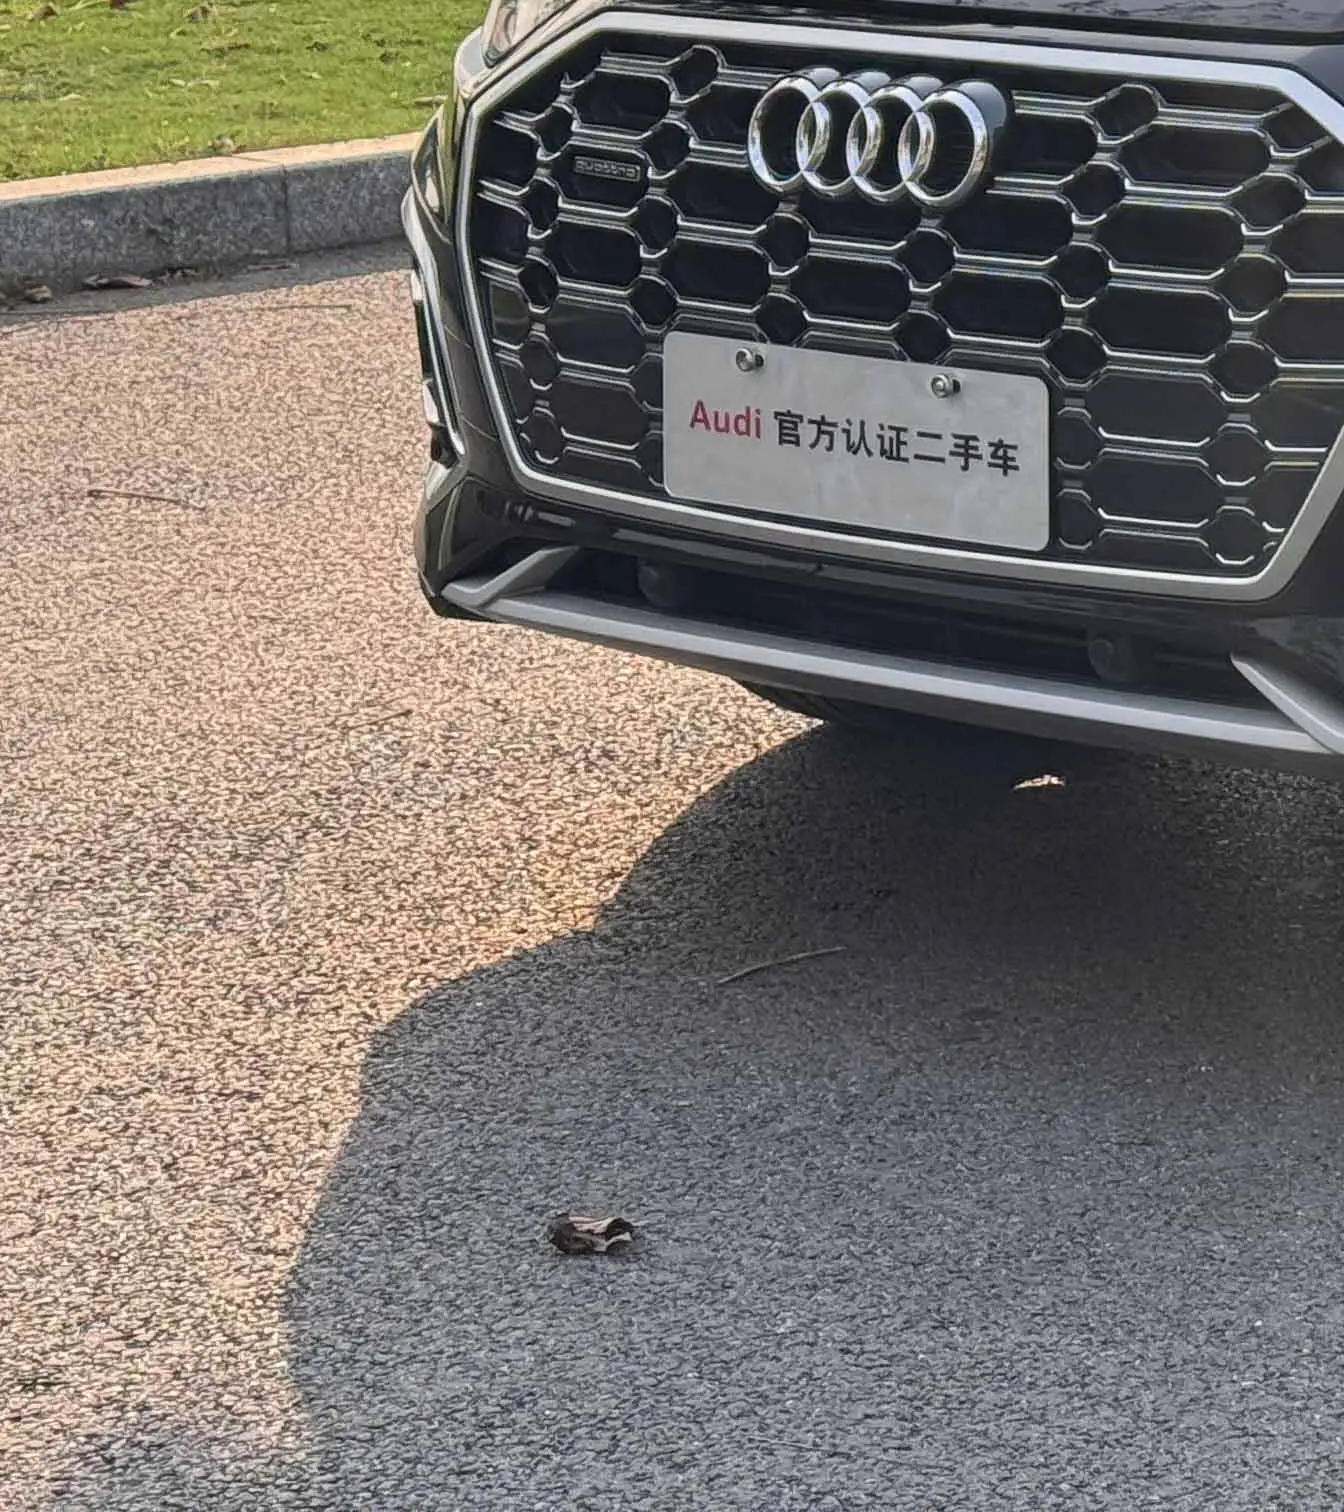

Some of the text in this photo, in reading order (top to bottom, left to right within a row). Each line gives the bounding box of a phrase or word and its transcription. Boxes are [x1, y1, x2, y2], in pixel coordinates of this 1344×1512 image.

[689, 399, 1021, 477] Audi 官方认证二手车
